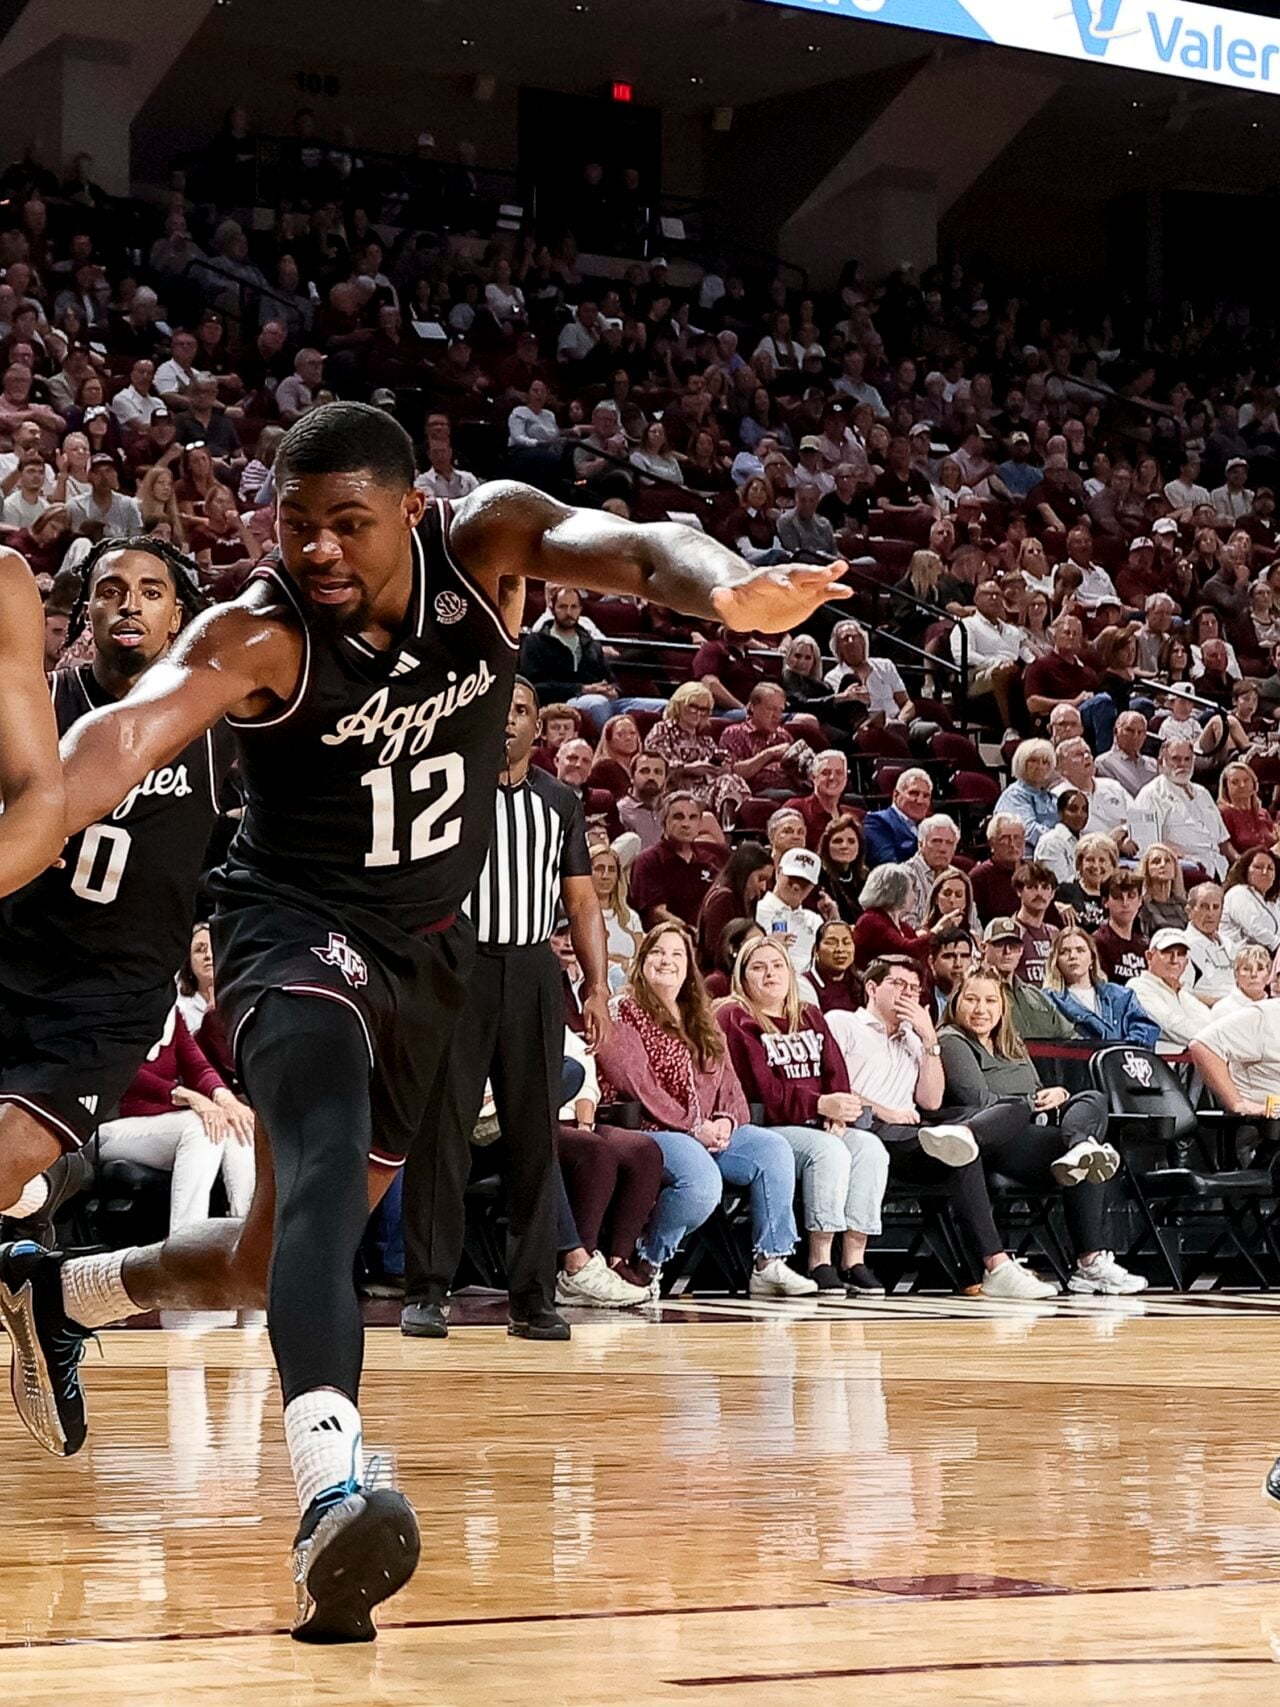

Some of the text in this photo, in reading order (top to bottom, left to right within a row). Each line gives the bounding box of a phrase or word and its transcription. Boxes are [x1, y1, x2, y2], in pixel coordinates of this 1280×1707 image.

[1147, 12, 1279, 81] Valer
[321, 660, 496, 766] Aggies
[361, 751, 465, 868] 12
[70, 823, 132, 905] 0
